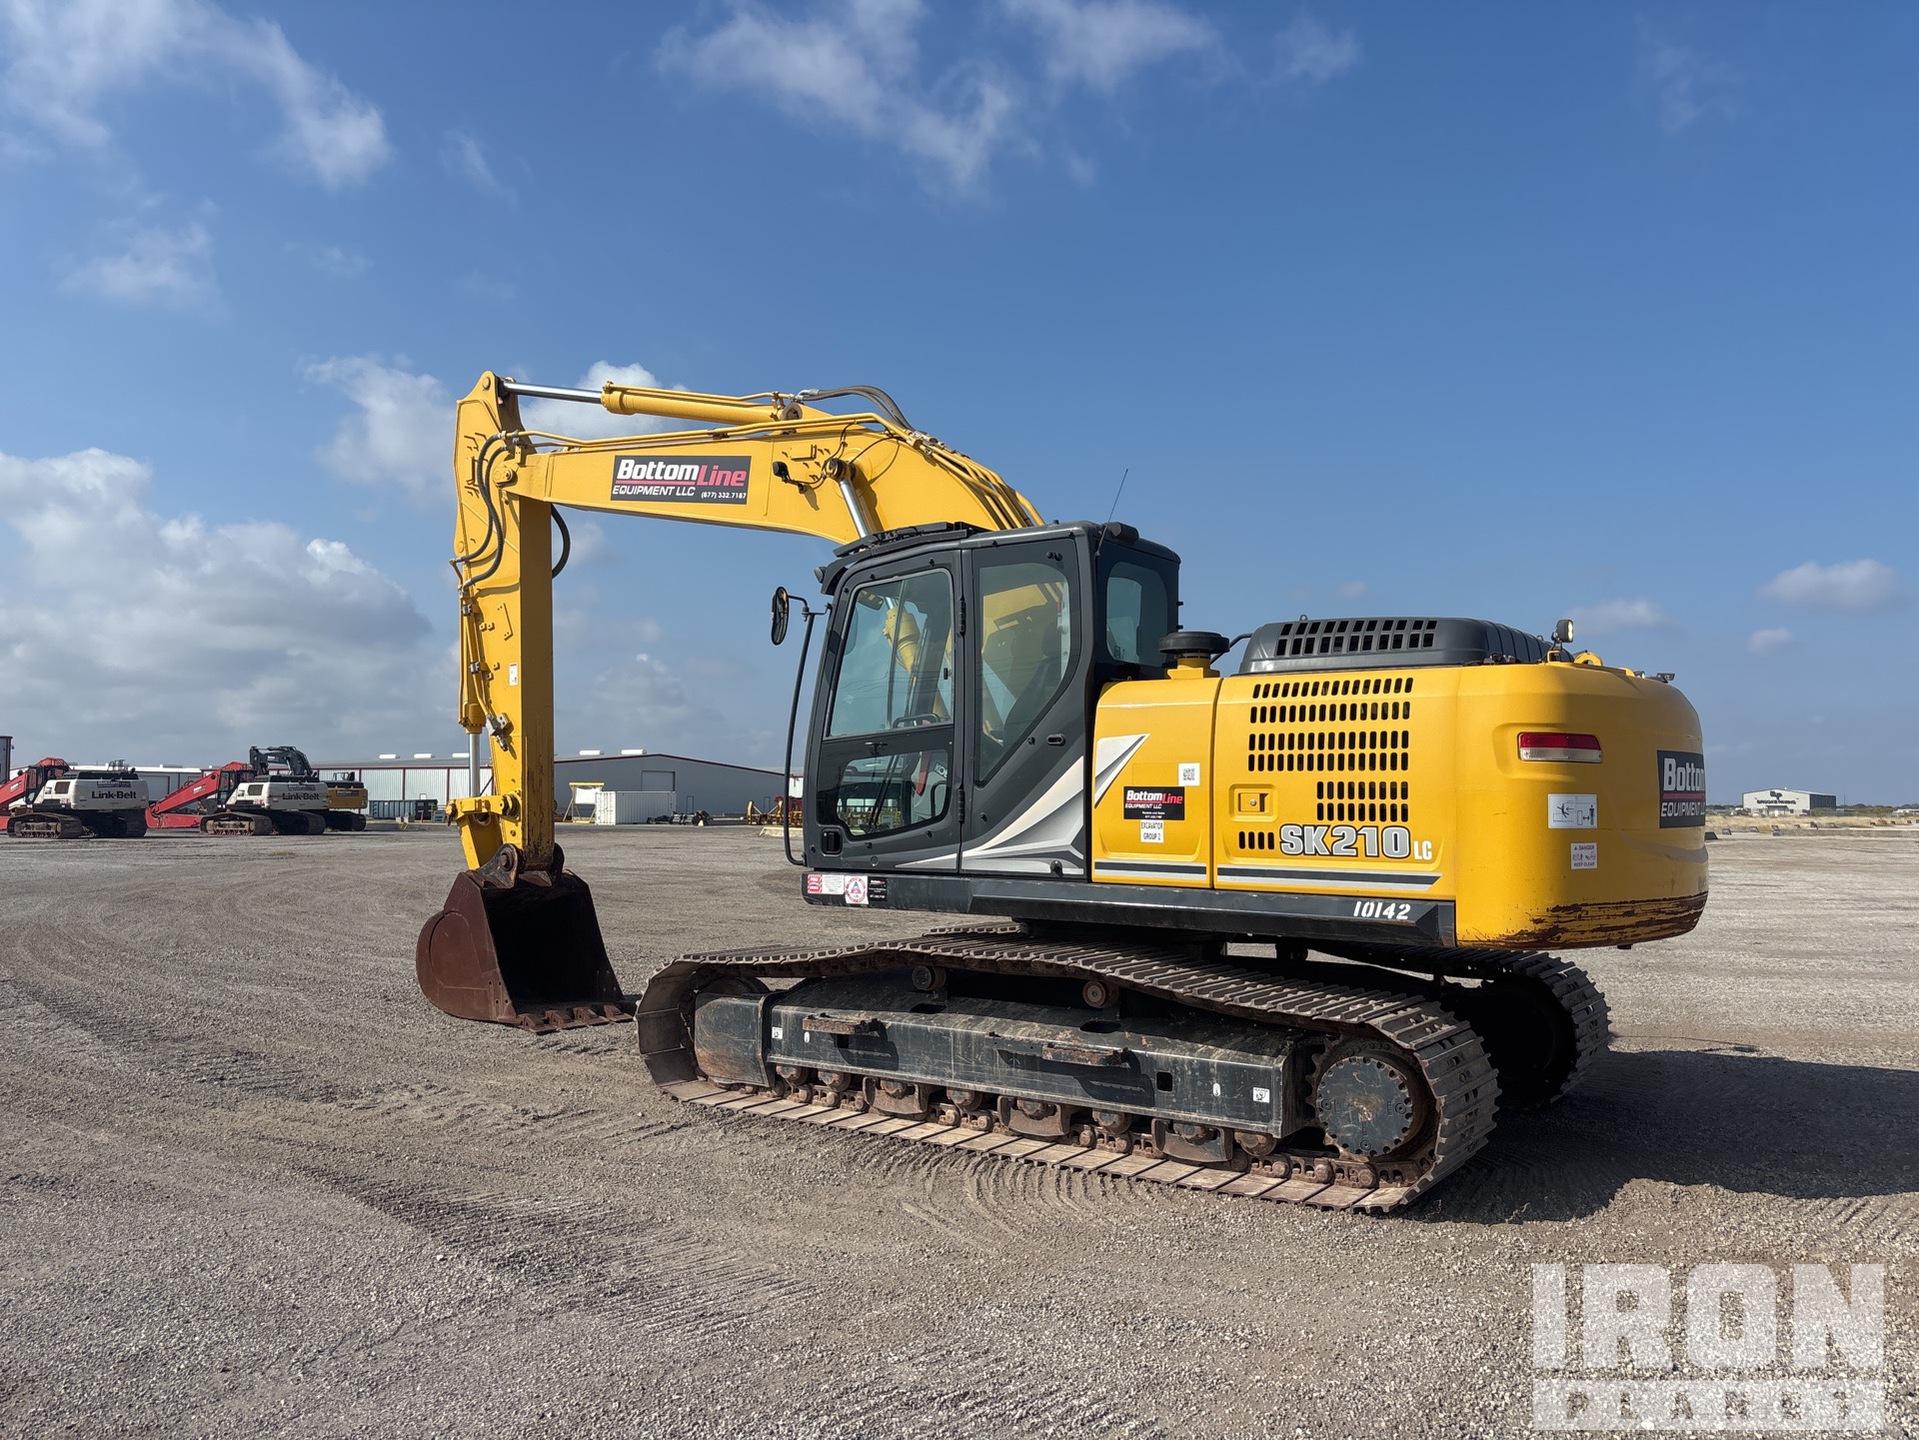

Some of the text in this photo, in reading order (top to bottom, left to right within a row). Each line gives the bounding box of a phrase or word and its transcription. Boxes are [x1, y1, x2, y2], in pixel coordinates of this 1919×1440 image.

[612, 485, 696, 496] EQUIPMENT LLC
[701, 491, 717, 499] (877)
[91, 791, 137, 799] Link-Belt
[1661, 802, 1700, 817] EQUIPMENT
[1143, 832, 1157, 840] GROUP
[1280, 824, 1432, 860] SK210 LC
[1354, 901, 1411, 920] 10142
